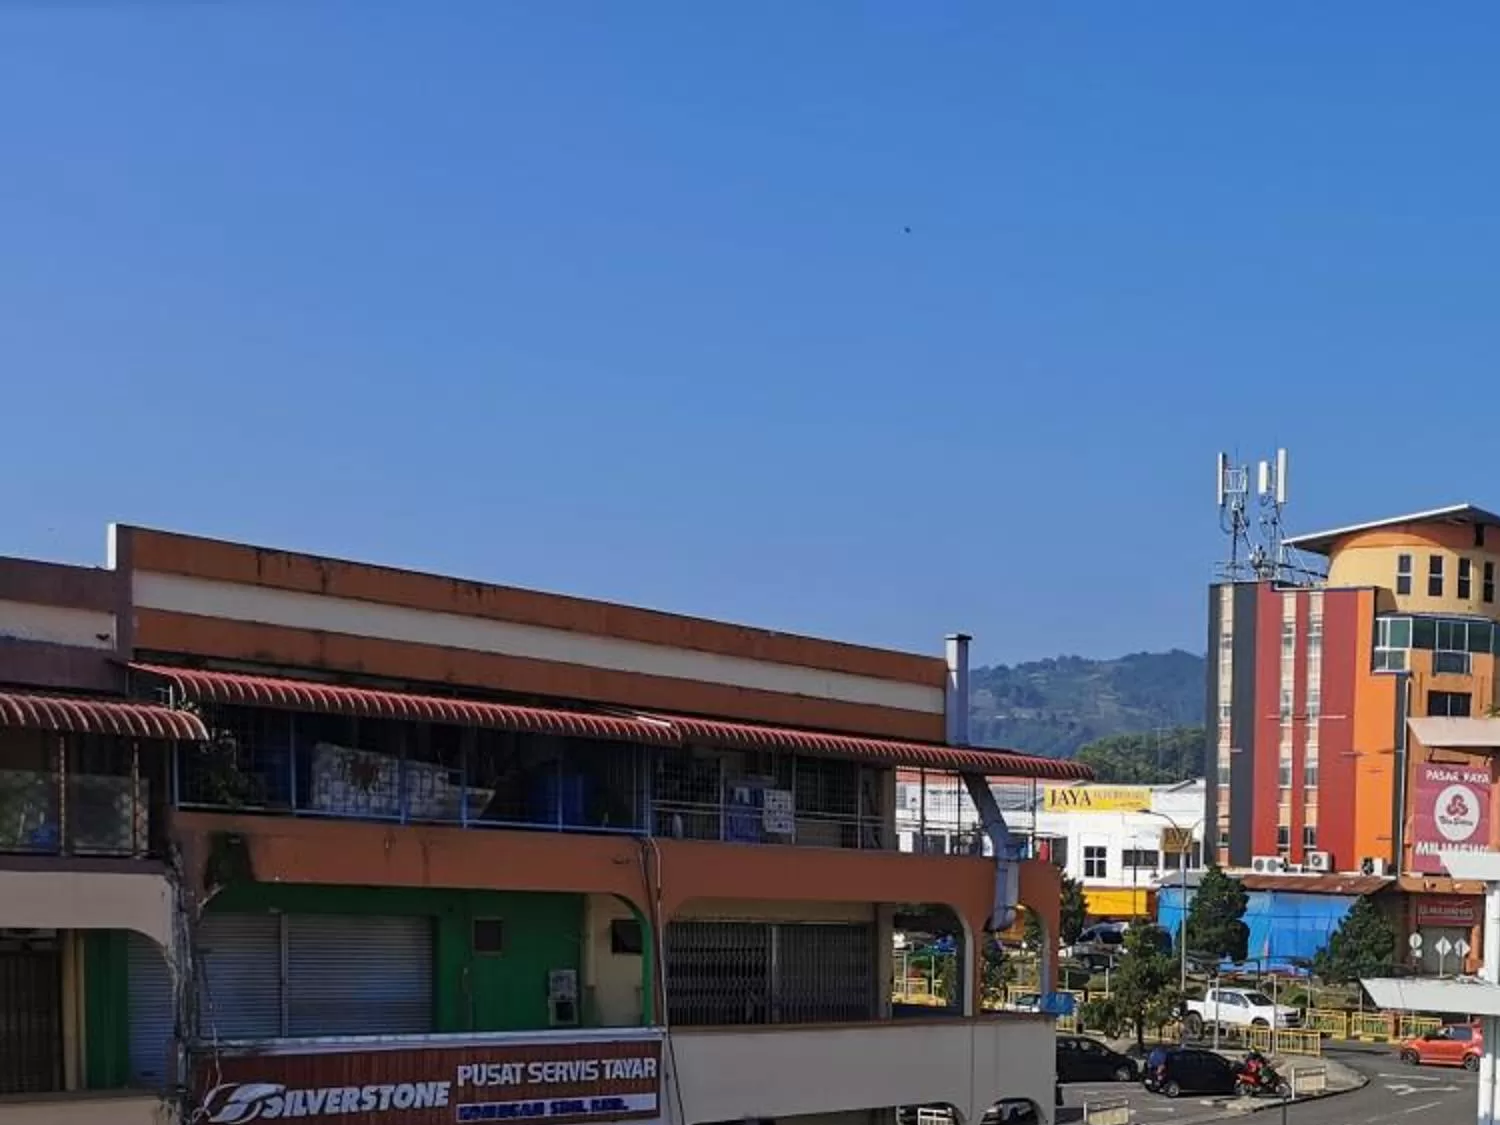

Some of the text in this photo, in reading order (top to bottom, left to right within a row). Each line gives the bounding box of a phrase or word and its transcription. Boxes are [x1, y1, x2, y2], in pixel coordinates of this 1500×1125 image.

[1051, 788, 1092, 806] JAYA
[457, 1057, 657, 1087] PUSAT SERVIS TAYAR
[259, 1081, 451, 1119] SILVERSTONE
